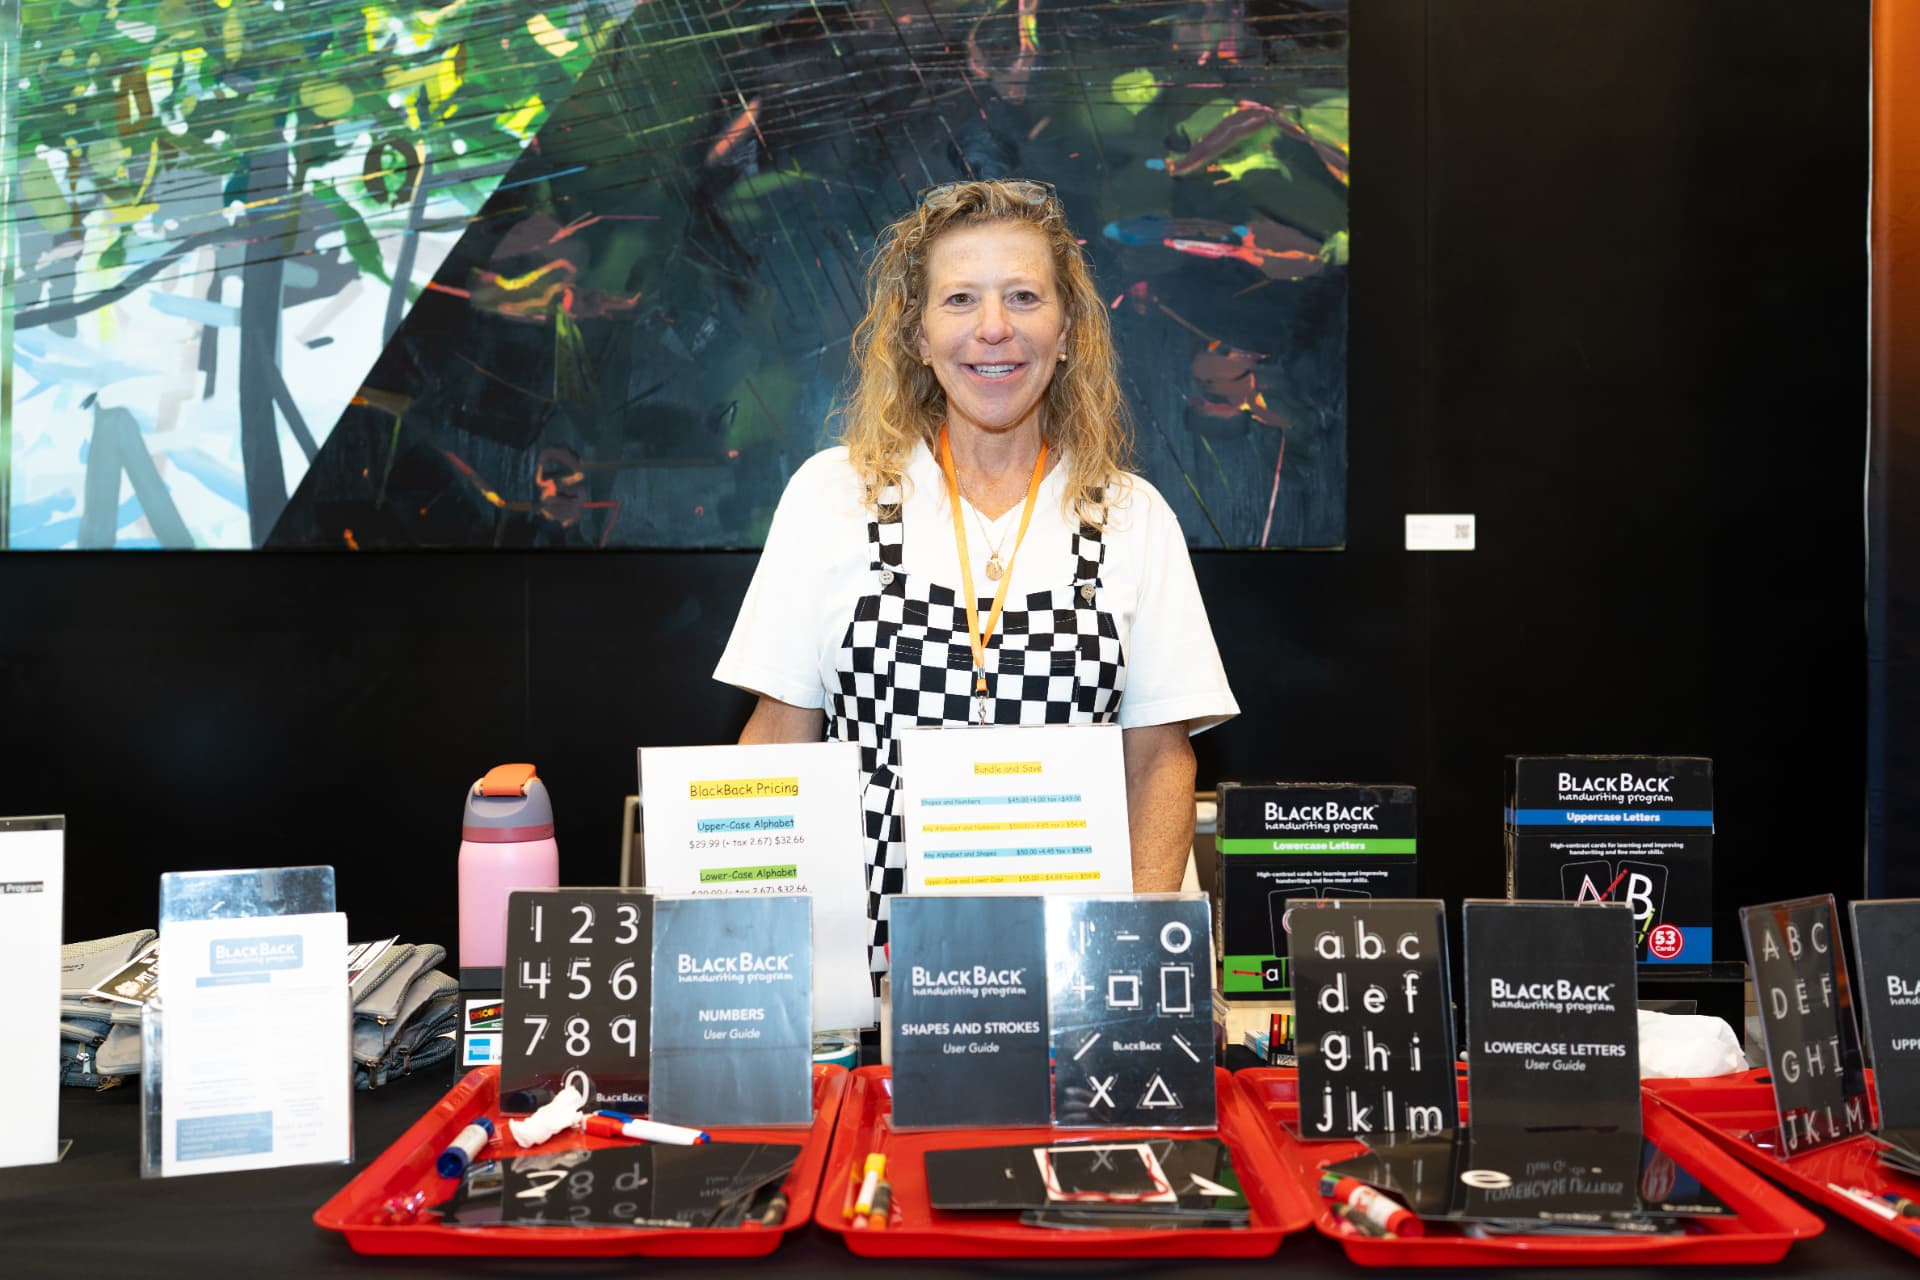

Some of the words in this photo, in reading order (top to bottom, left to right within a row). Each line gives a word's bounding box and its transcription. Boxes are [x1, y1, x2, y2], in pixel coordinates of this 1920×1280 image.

[974, 763, 1001, 774] Bundle
[1022, 764, 1042, 773] Save
[690, 783, 753, 797] BlackBack
[756, 782, 799, 797] Pricing
[1558, 792, 1625, 804] handwriting
[1627, 793, 1674, 804] program
[1566, 812, 1621, 823] Uppercase
[1623, 812, 1661, 822] Letters
[697, 820, 751, 832] Upper-Case
[754, 818, 794, 830] Alphabet
[1264, 822, 1331, 833] handwriting
[1333, 823, 1379, 833] program
[689, 840, 720, 849] $29.99
[733, 839, 747, 847] tax
[750, 837, 772, 847] 2.67)
[775, 836, 805, 846] $32.66
[1273, 841, 1328, 850] Lowercase
[1329, 841, 1366, 850] Letters
[700, 870, 753, 882] Lower-Case
[756, 868, 797, 879] Alphabet
[1625, 873, 1653, 920] B
[535, 905, 543, 943] 1
[569, 905, 593, 943] 2
[615, 905, 638, 944] 3
[1318, 935, 1341, 960] a
[1358, 919, 1382, 960] b
[1400, 935, 1420, 960] c
[1655, 930, 1676, 945] 53
[1764, 929, 1780, 962] A
[1786, 926, 1801, 957] B
[1812, 922, 1828, 953] C
[523, 961, 551, 999] 4
[568, 961, 592, 1000] 5
[613, 962, 638, 1001] 6
[678, 973, 745, 984] handwriting
[747, 972, 794, 984] program
[1266, 968, 1279, 981] a
[912, 986, 979, 998] handwriting
[981, 987, 1026, 998] program
[1321, 972, 1345, 1013] d
[1363, 988, 1386, 1014] e
[1405, 973, 1420, 1014] f
[1771, 987, 1788, 1020] D
[1796, 982, 1811, 1014] E
[1821, 977, 1832, 1008] F
[1492, 1000, 1563, 1013] handwriting
[1566, 1001, 1616, 1014] program
[699, 1008, 765, 1022] NUMBERS
[703, 1029, 726, 1040] User
[729, 1028, 761, 1039] Guide
[901, 1023, 950, 1035] SHAPES
[952, 1023, 982, 1034] AND
[984, 1021, 1040, 1034] STROKES
[524, 1017, 548, 1056] 7
[565, 1017, 591, 1056] 8
[943, 1042, 967, 1054] User
[968, 1042, 1000, 1053] Guide
[1324, 1034, 1347, 1071] g
[1367, 1030, 1388, 1071] h
[1412, 1036, 1421, 1071] i
[1484, 1041, 1568, 1055] LOWERCASE
[1570, 1043, 1626, 1056] LETTERS
[1525, 1059, 1551, 1071] User
[1552, 1059, 1587, 1071] Guide
[1782, 1050, 1800, 1083] G
[1806, 1044, 1824, 1077] H
[1829, 1040, 1843, 1073] I
[1316, 1086, 1333, 1132] j
[1350, 1090, 1372, 1132] k
[1409, 1105, 1443, 1133] m
[1786, 1115, 1798, 1150] J
[1804, 1110, 1820, 1144] K
[1826, 1106, 1841, 1138] L
[1846, 1096, 1864, 1133] M
